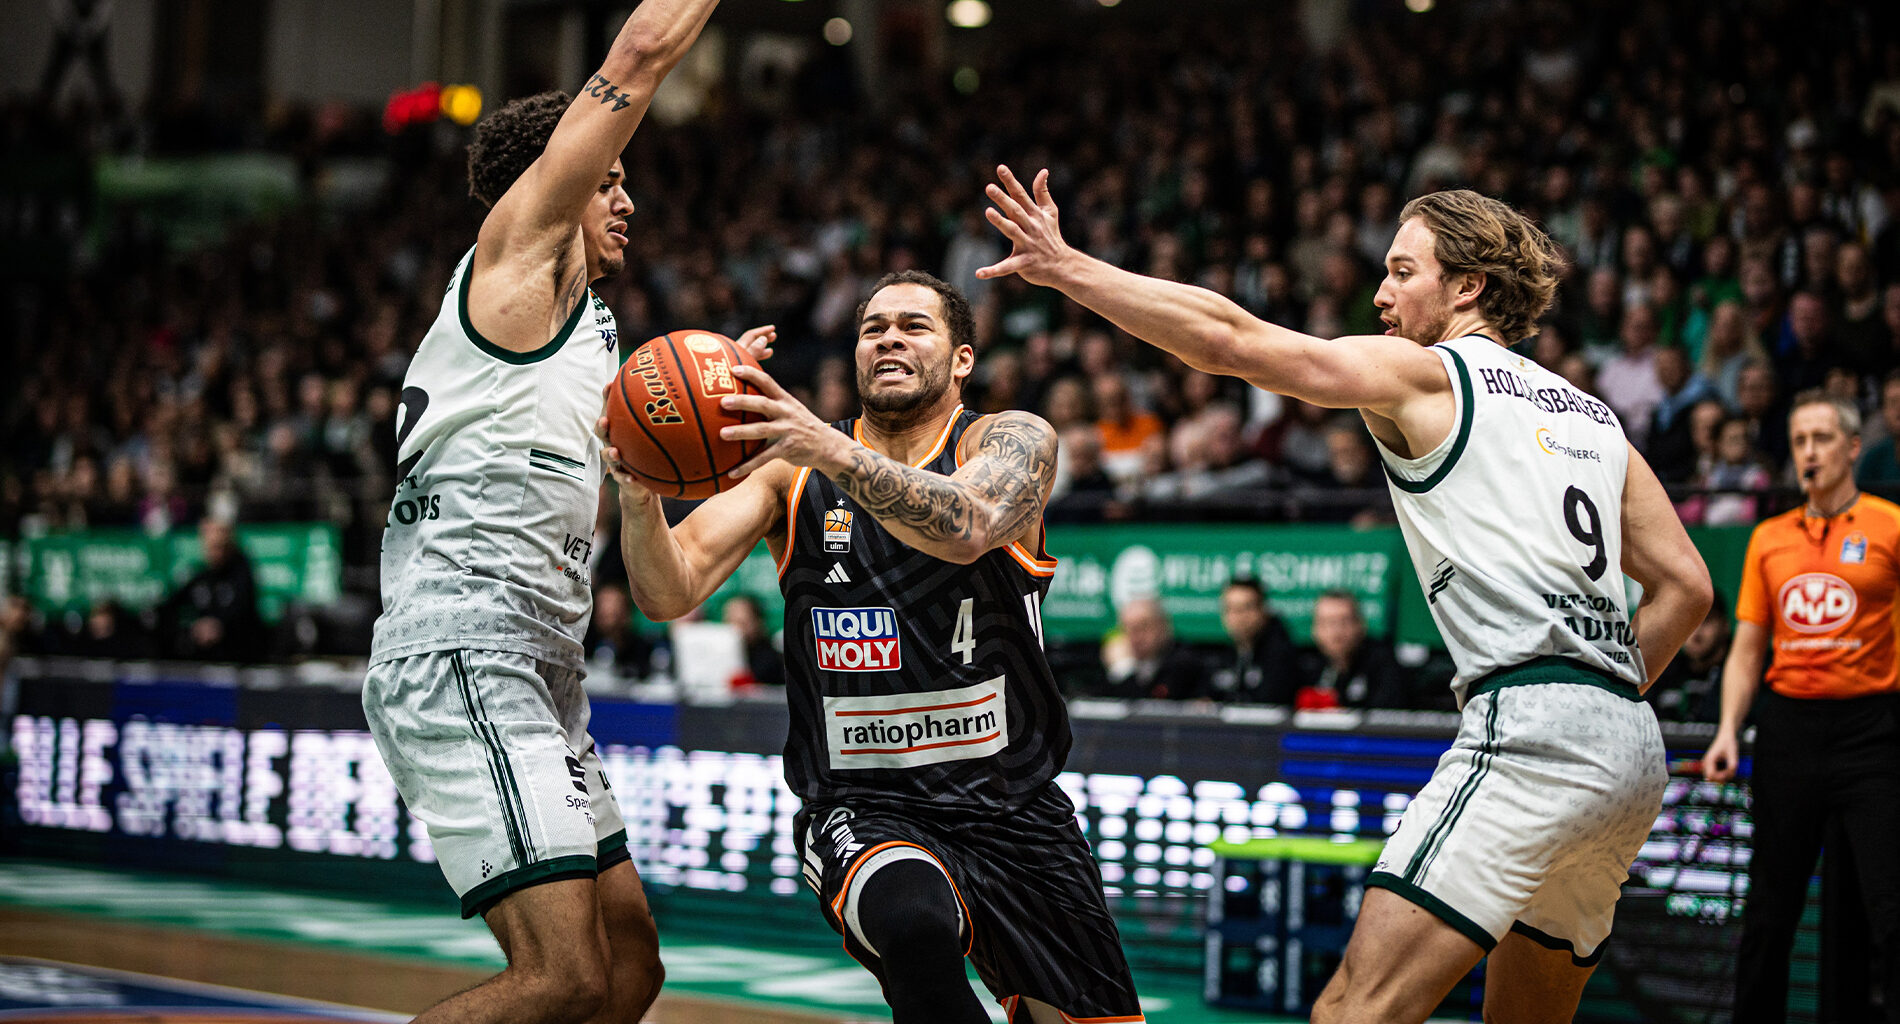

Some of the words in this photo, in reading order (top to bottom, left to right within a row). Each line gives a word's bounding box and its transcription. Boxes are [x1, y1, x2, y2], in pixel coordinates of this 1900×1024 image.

[631, 344, 685, 425] Baden
[716, 358, 733, 389] BBL
[387, 494, 440, 527] ORS
[830, 542, 844, 550] ulm
[1564, 485, 1607, 582] 9
[816, 611, 894, 640] LIQUI
[951, 598, 976, 664] 4
[820, 640, 897, 668] MOLY
[843, 710, 997, 748] ratiopharm
